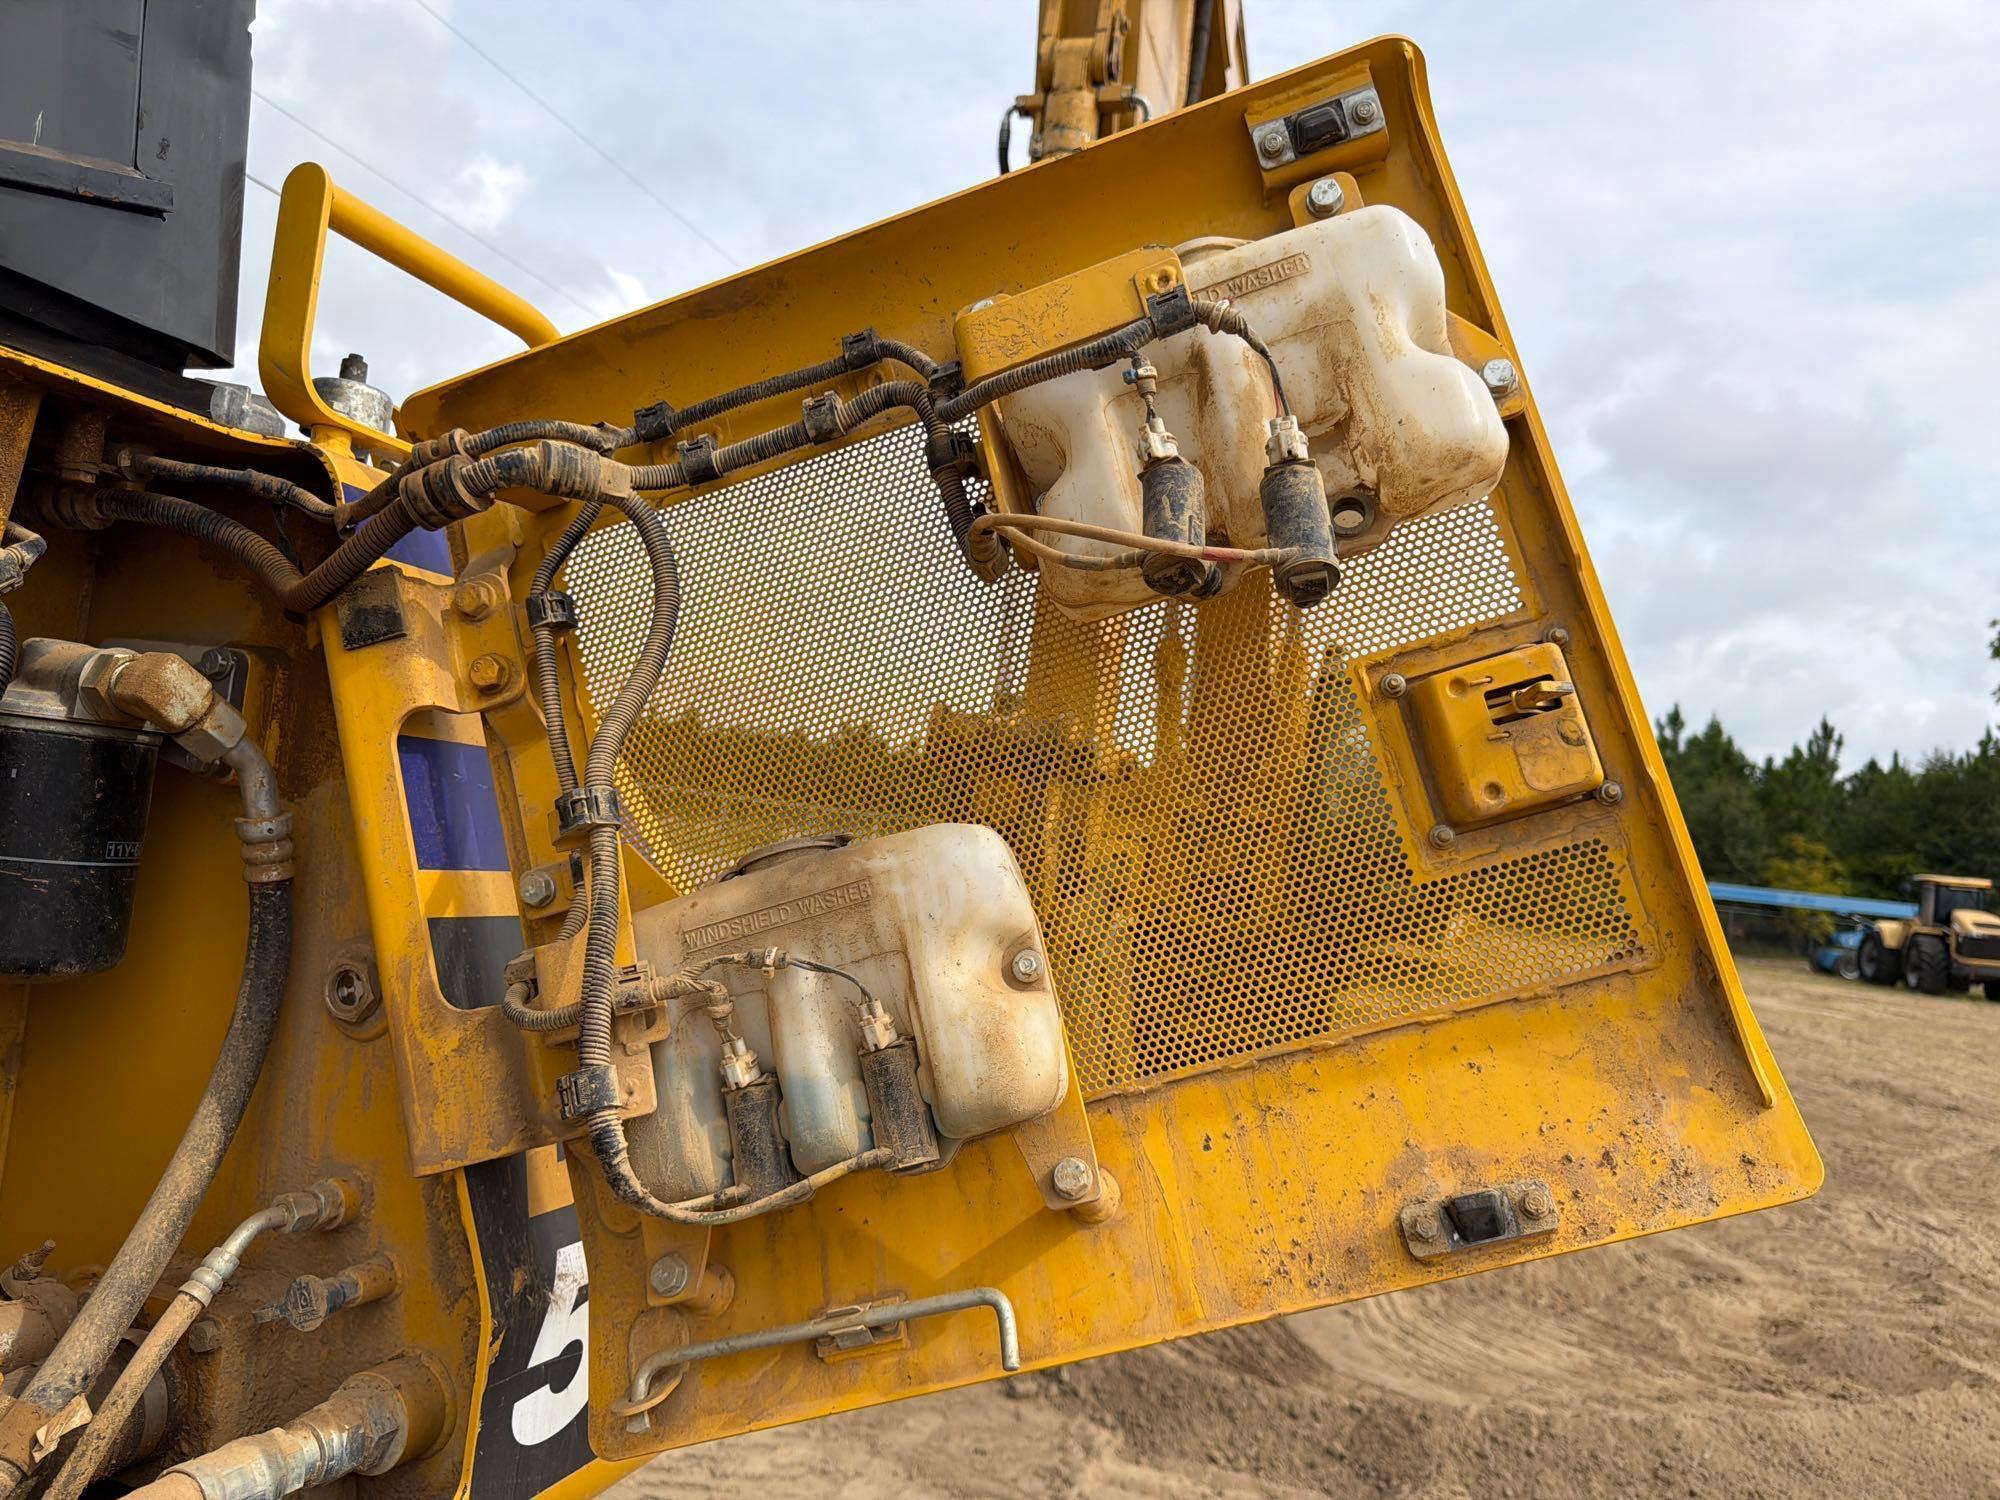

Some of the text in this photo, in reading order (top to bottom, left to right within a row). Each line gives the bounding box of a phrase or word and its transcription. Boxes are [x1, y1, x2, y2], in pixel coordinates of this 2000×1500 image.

[1227, 257, 1310, 296] WASHER
[685, 881, 872, 948] WINDSHIELD WASHER
